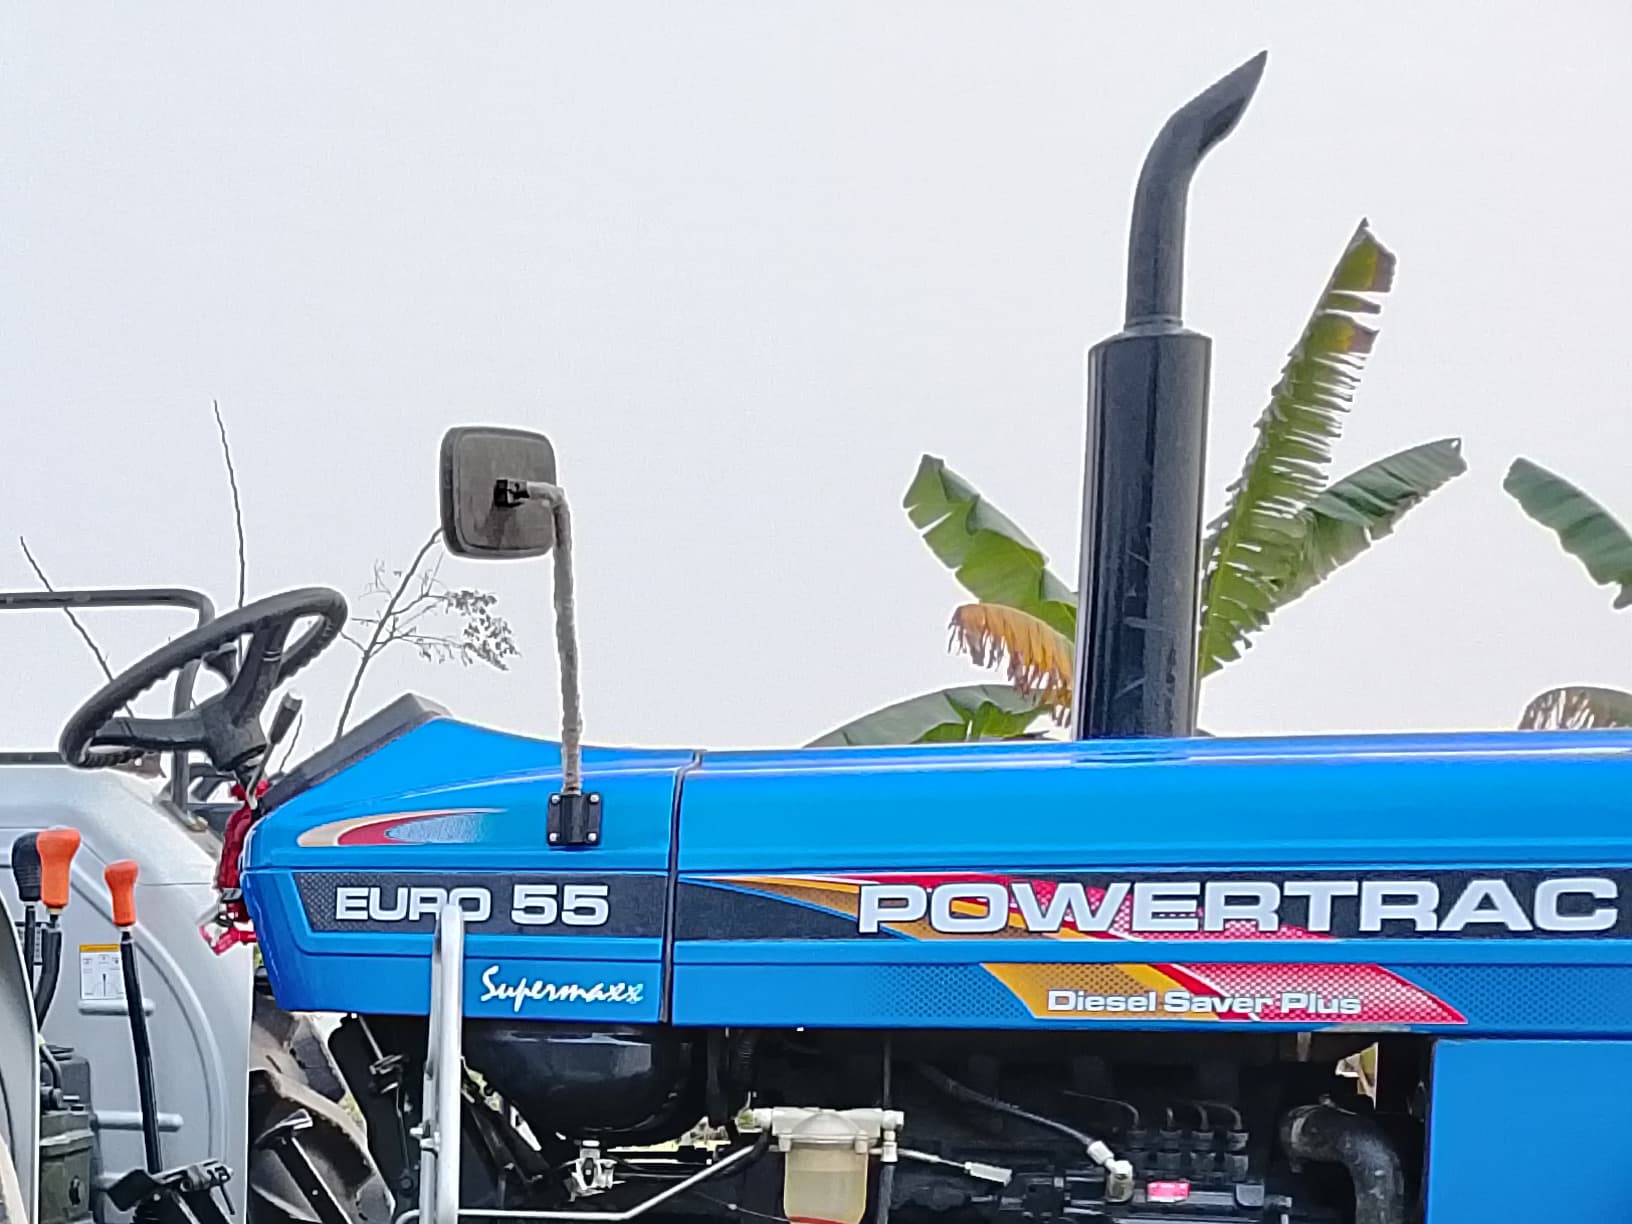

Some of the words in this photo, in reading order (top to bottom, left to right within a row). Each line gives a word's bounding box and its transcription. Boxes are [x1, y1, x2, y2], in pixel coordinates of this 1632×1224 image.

[335, 886, 491, 922] EURO
[511, 884, 609, 925] 55
[857, 878, 1619, 934] POWERTRAC
[480, 965, 644, 1012] Supermaxx
[1047, 988, 1158, 1014] Diesel
[1163, 990, 1274, 1015] Saver
[1280, 990, 1362, 1016] Plus
